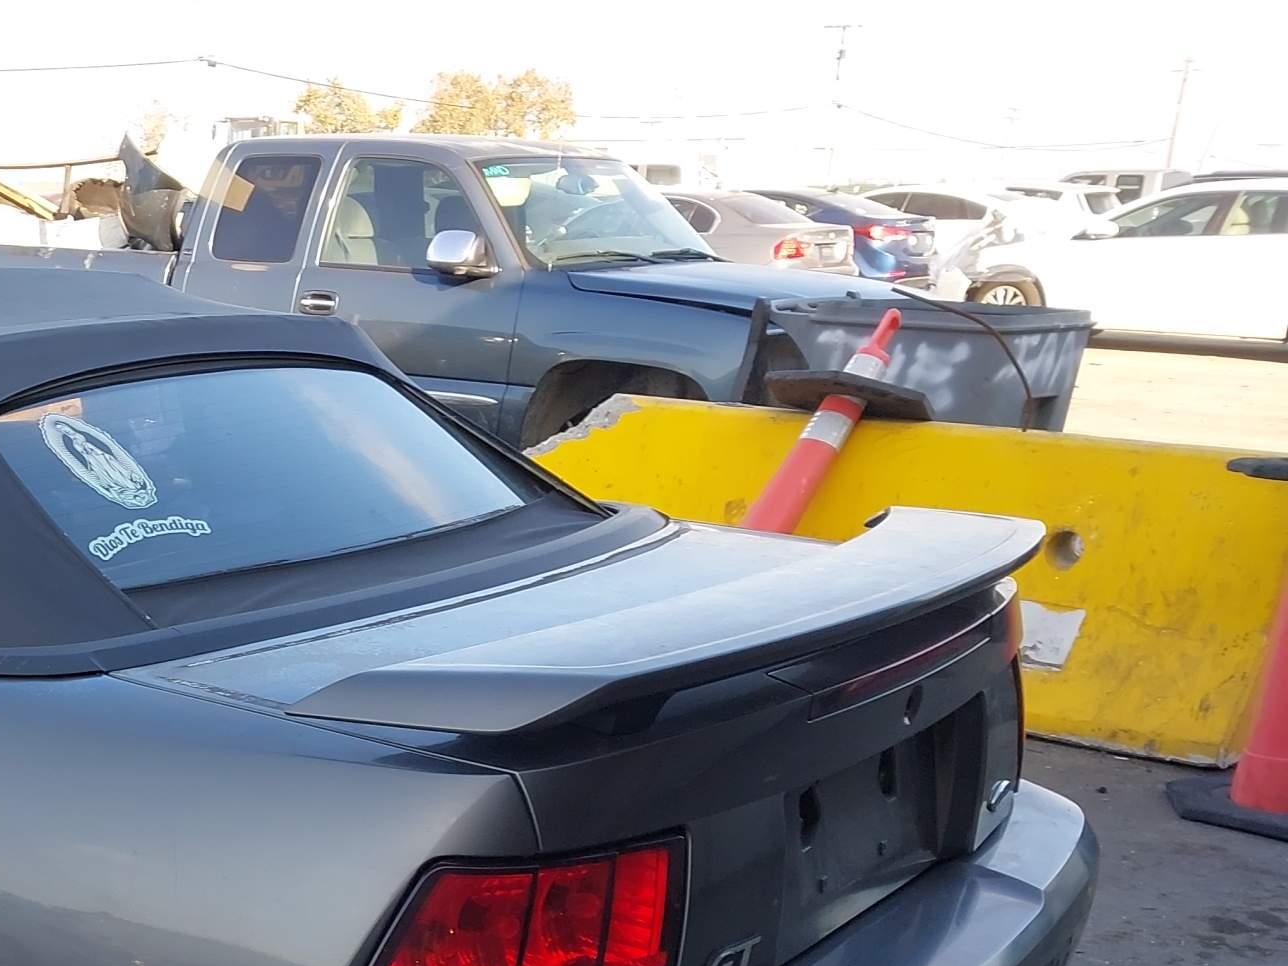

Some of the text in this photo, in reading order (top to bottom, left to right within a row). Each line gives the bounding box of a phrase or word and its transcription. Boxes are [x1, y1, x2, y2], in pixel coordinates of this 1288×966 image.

[93, 518, 209, 557] Dios Te Bendiga
